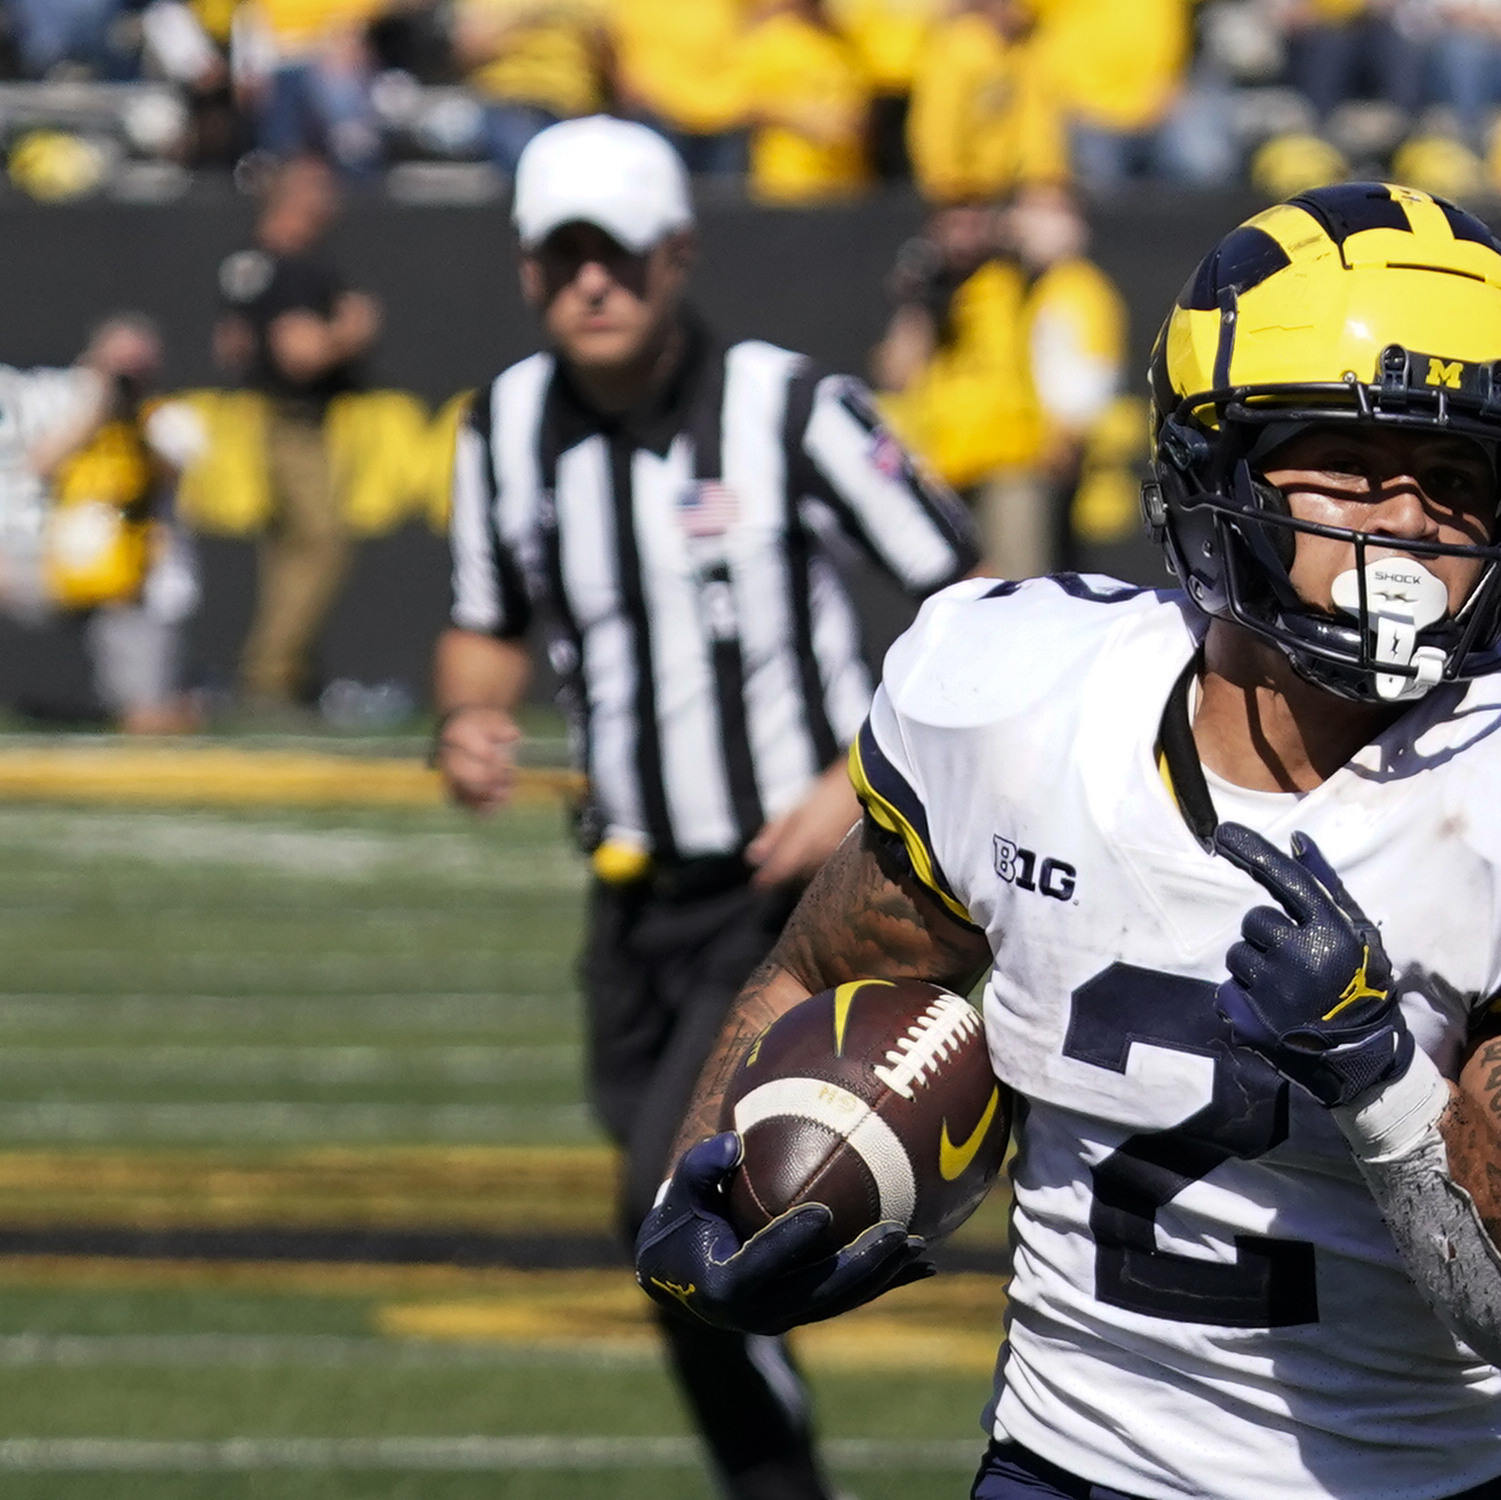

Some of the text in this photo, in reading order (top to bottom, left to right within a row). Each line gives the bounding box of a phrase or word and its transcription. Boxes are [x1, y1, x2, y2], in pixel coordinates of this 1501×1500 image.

[1425, 357, 1464, 389] M
[1374, 570, 1422, 586] SHOCK
[1060, 960, 1321, 1329] 2
